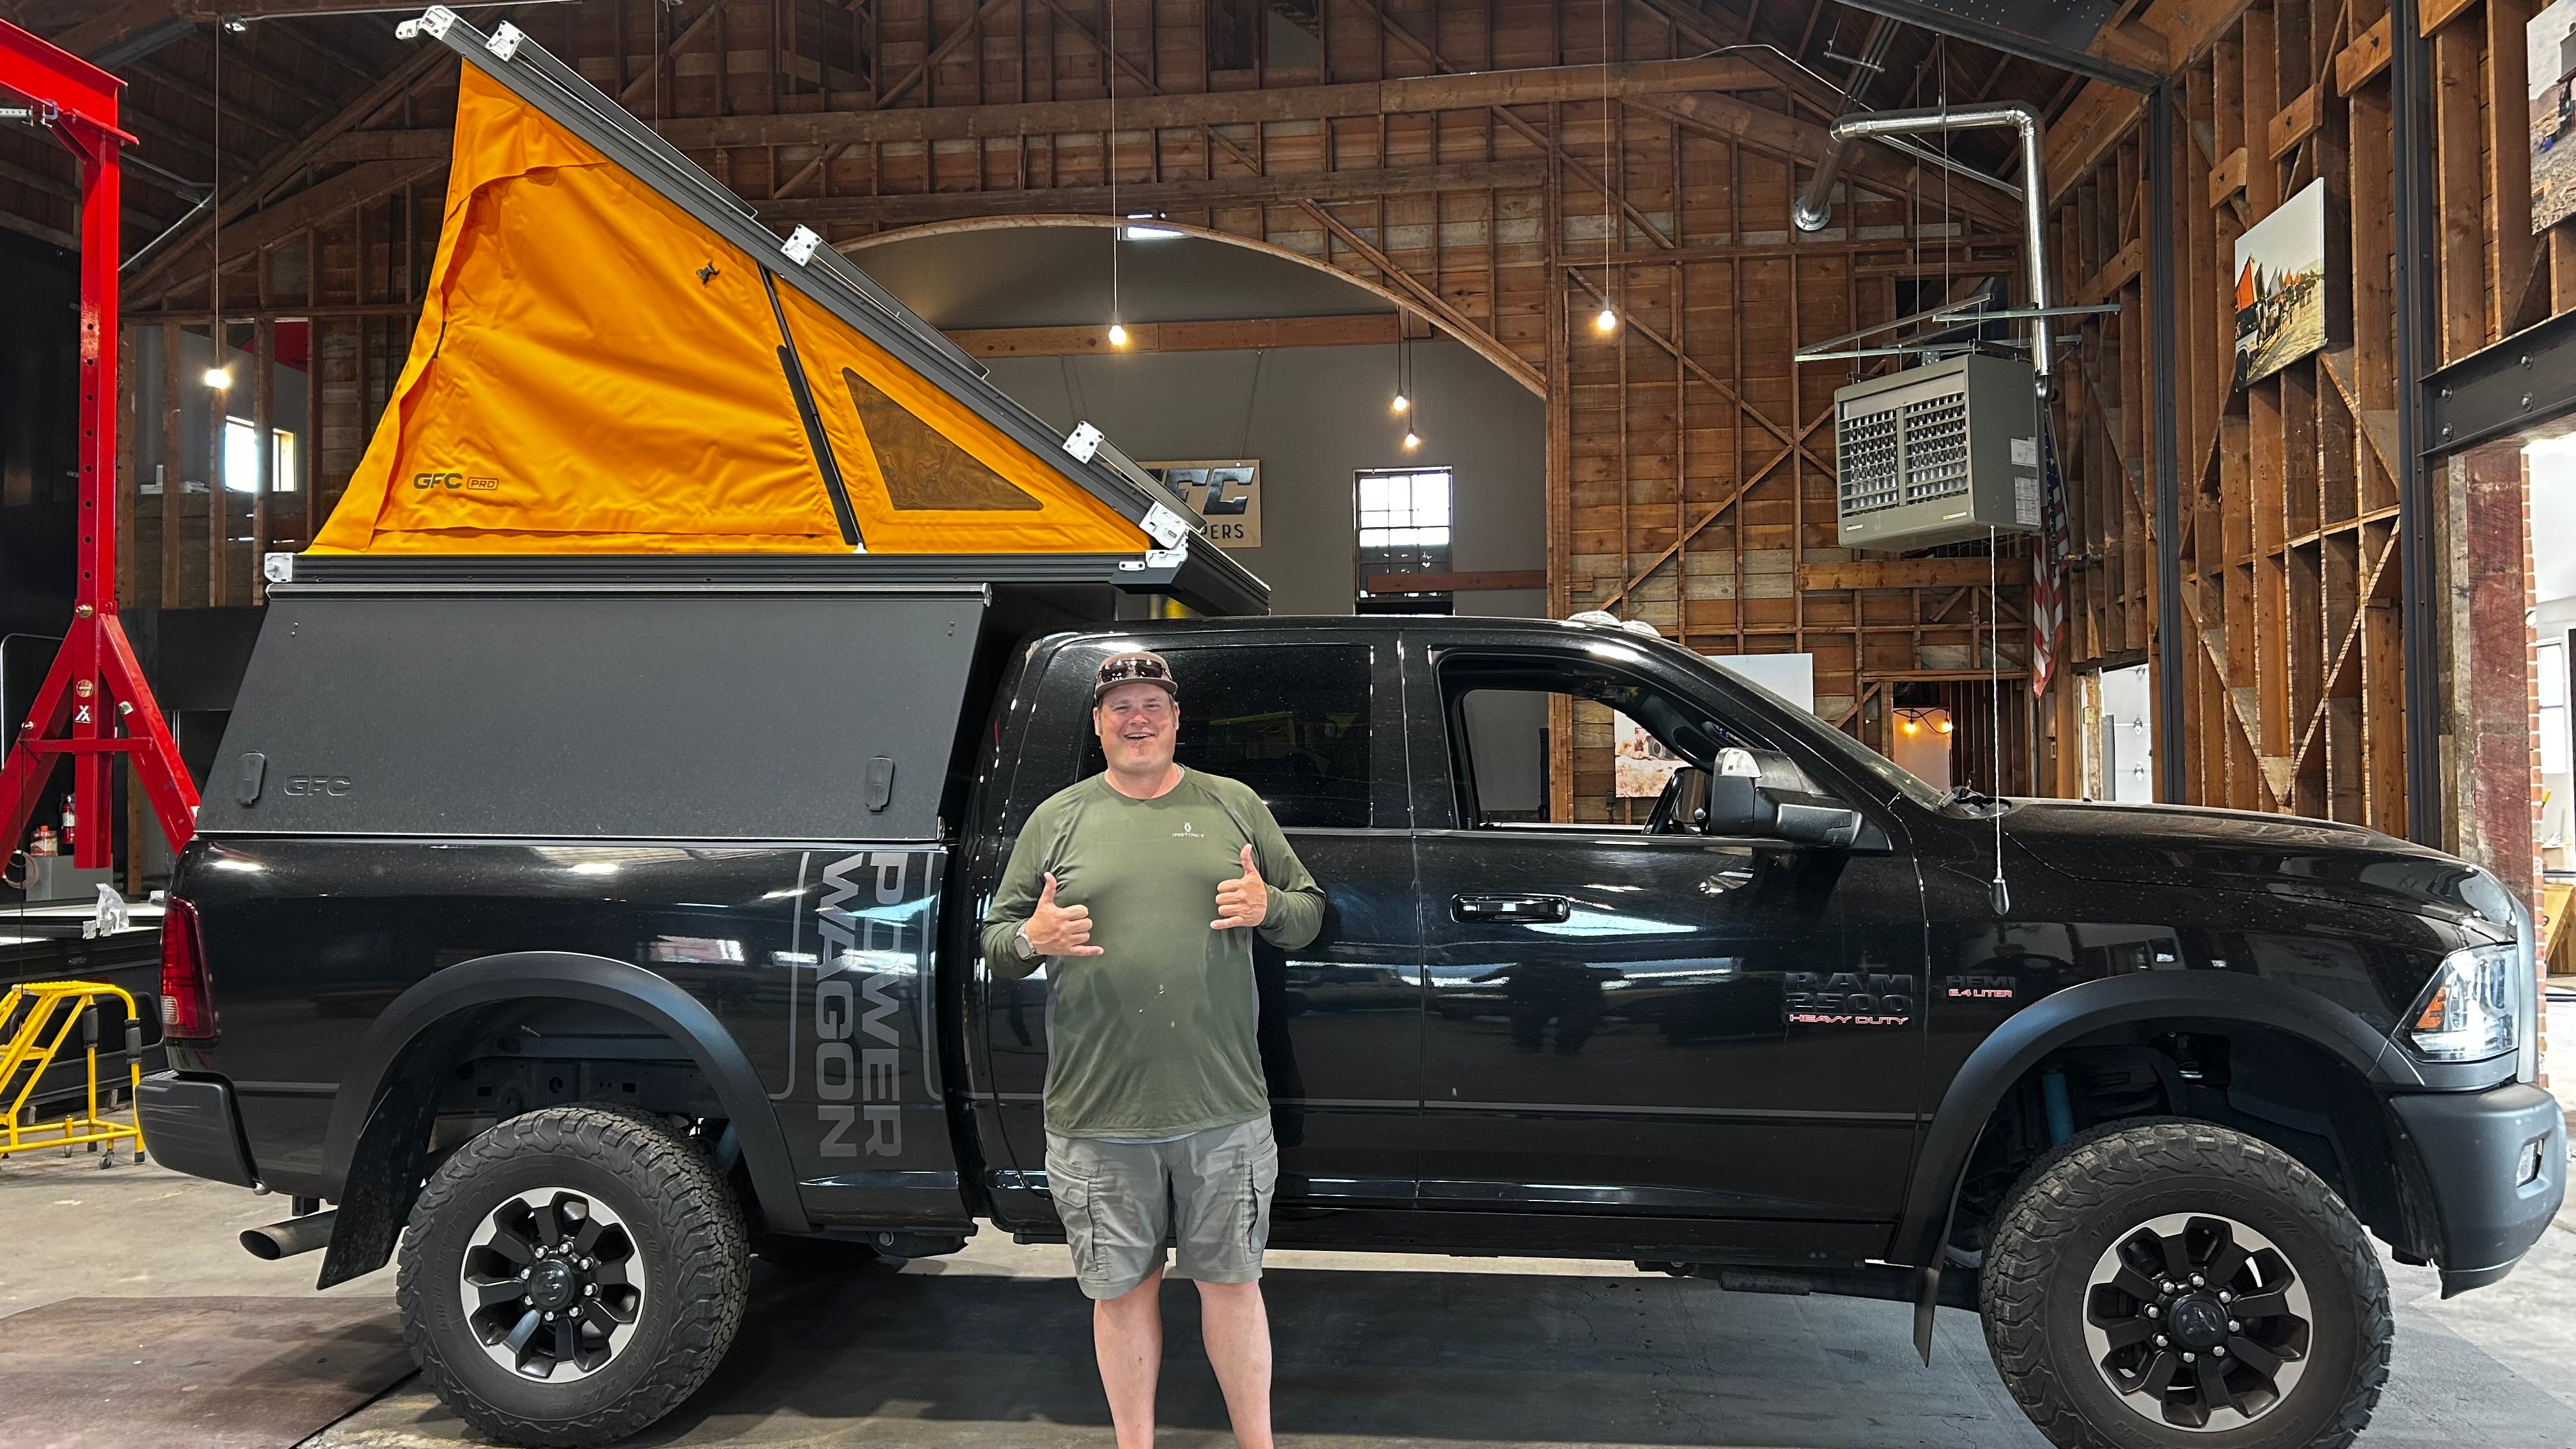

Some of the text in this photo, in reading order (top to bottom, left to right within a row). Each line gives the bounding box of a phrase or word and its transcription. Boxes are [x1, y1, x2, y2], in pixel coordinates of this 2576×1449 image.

[413, 473, 495, 489] GFC PRO
[1146, 467, 1255, 515] FC
[284, 775, 351, 796] GFC
[1785, 972, 1913, 992] RAM
[1946, 975, 2015, 988] HEMI
[1785, 993, 1913, 1013] 2500
[1949, 988, 2012, 998] 6.4 LITER
[816, 852, 864, 1158] WAGON
[862, 852, 909, 1158] POWER
[1790, 1014, 1908, 1025] HEAVY DUTY
